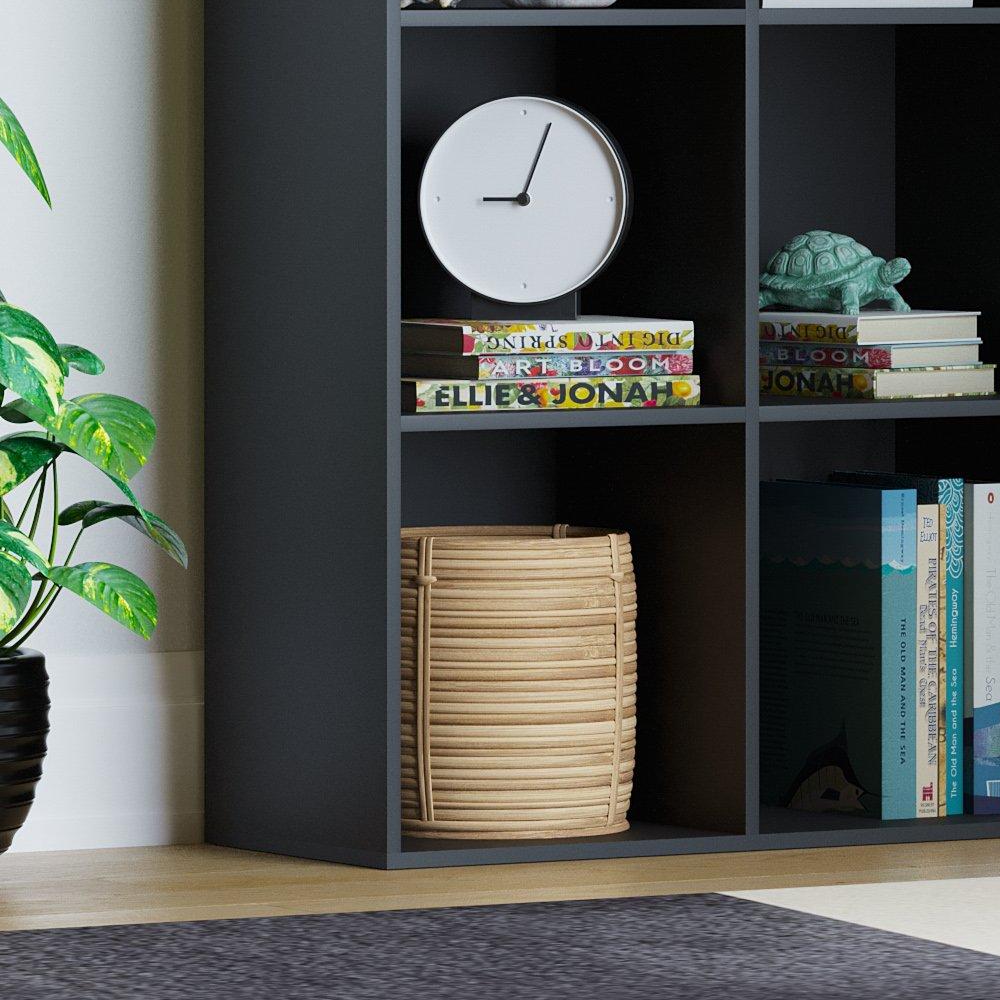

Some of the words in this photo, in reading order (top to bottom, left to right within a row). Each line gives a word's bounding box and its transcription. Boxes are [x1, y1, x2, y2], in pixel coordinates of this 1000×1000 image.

[487, 334, 568, 350] SPRING
[578, 332, 634, 347] INTO
[643, 332, 681, 346] DIG
[816, 325, 847, 340] DIG
[778, 347, 870, 362] BLOOM
[491, 358, 552, 378] ART
[570, 357, 673, 373] BLOOM
[760, 369, 853, 393] JONAH
[553, 381, 673, 405] JONAH
[926, 558, 937, 620] PIRATES
[950, 588, 959, 648] Hemingway
[927, 621, 937, 641] OF
[986, 676, 996, 701] Sea
[925, 680, 937, 766] CARIBBEAN
